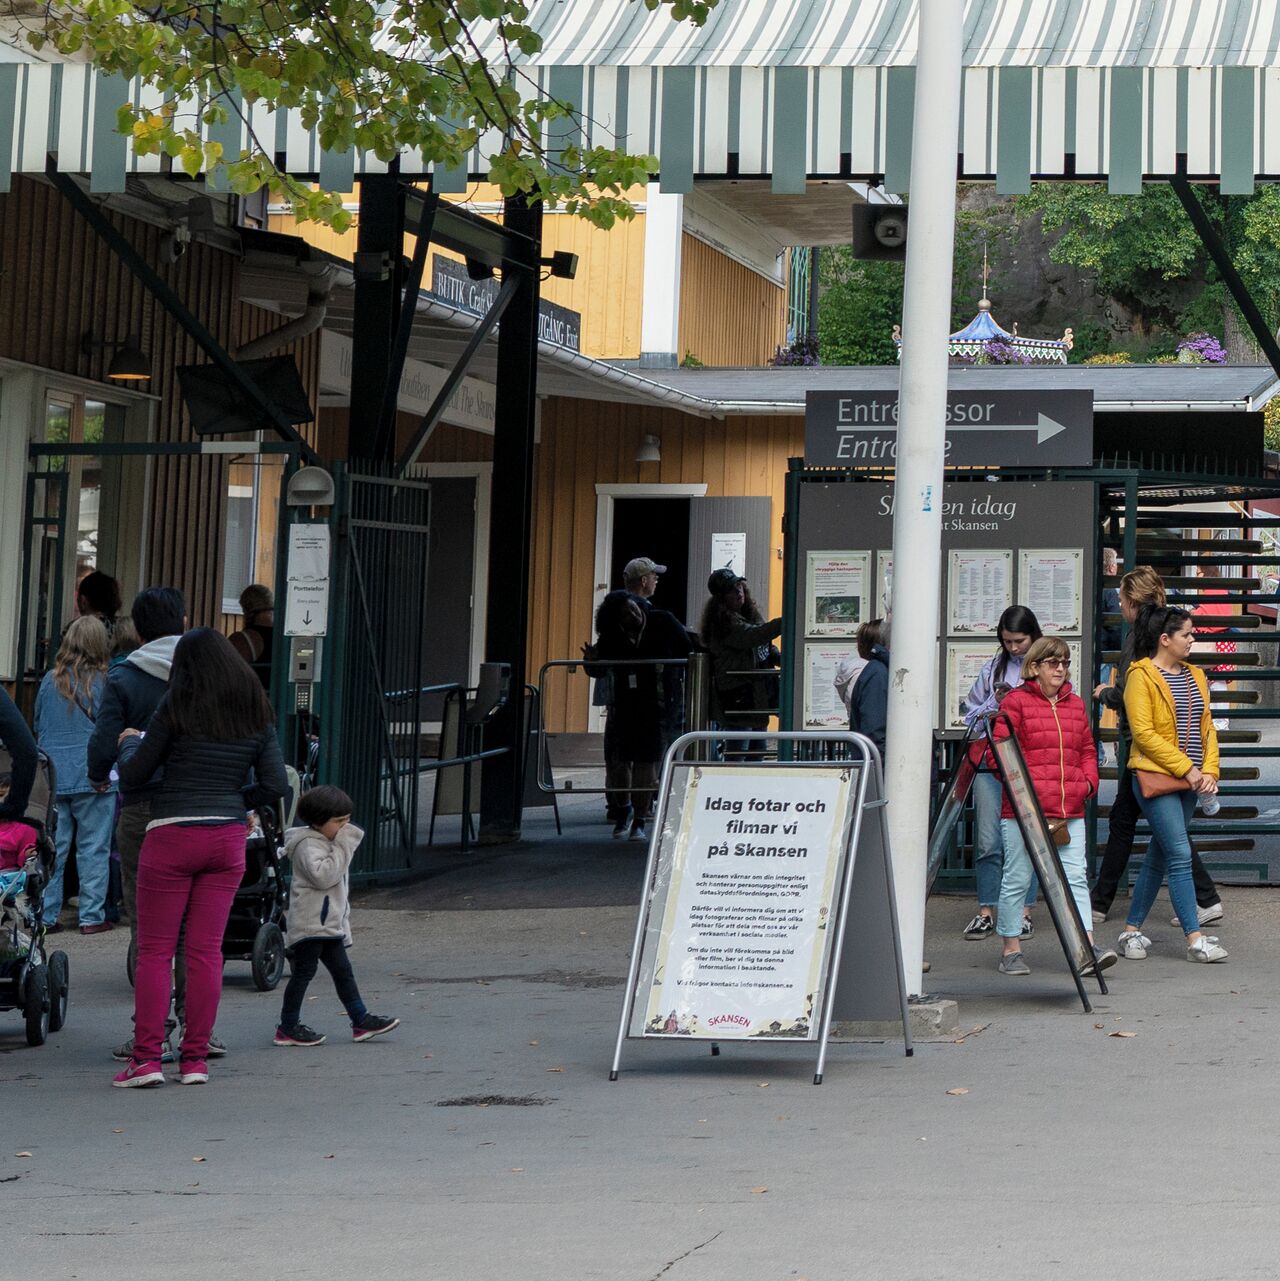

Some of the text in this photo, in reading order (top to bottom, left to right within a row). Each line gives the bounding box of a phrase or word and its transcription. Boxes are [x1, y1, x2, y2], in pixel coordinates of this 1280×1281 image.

[438, 272, 465, 304] BUTIK
[566, 324, 578, 349] Exit
[971, 495, 1016, 520] idag
[952, 520, 998, 530] Skansen
[705, 797, 826, 814] Idag fotar och
[726, 819, 798, 834] filmar vi
[707, 841, 807, 858] på Skansen
[708, 1014, 751, 1027] SKANSEN
